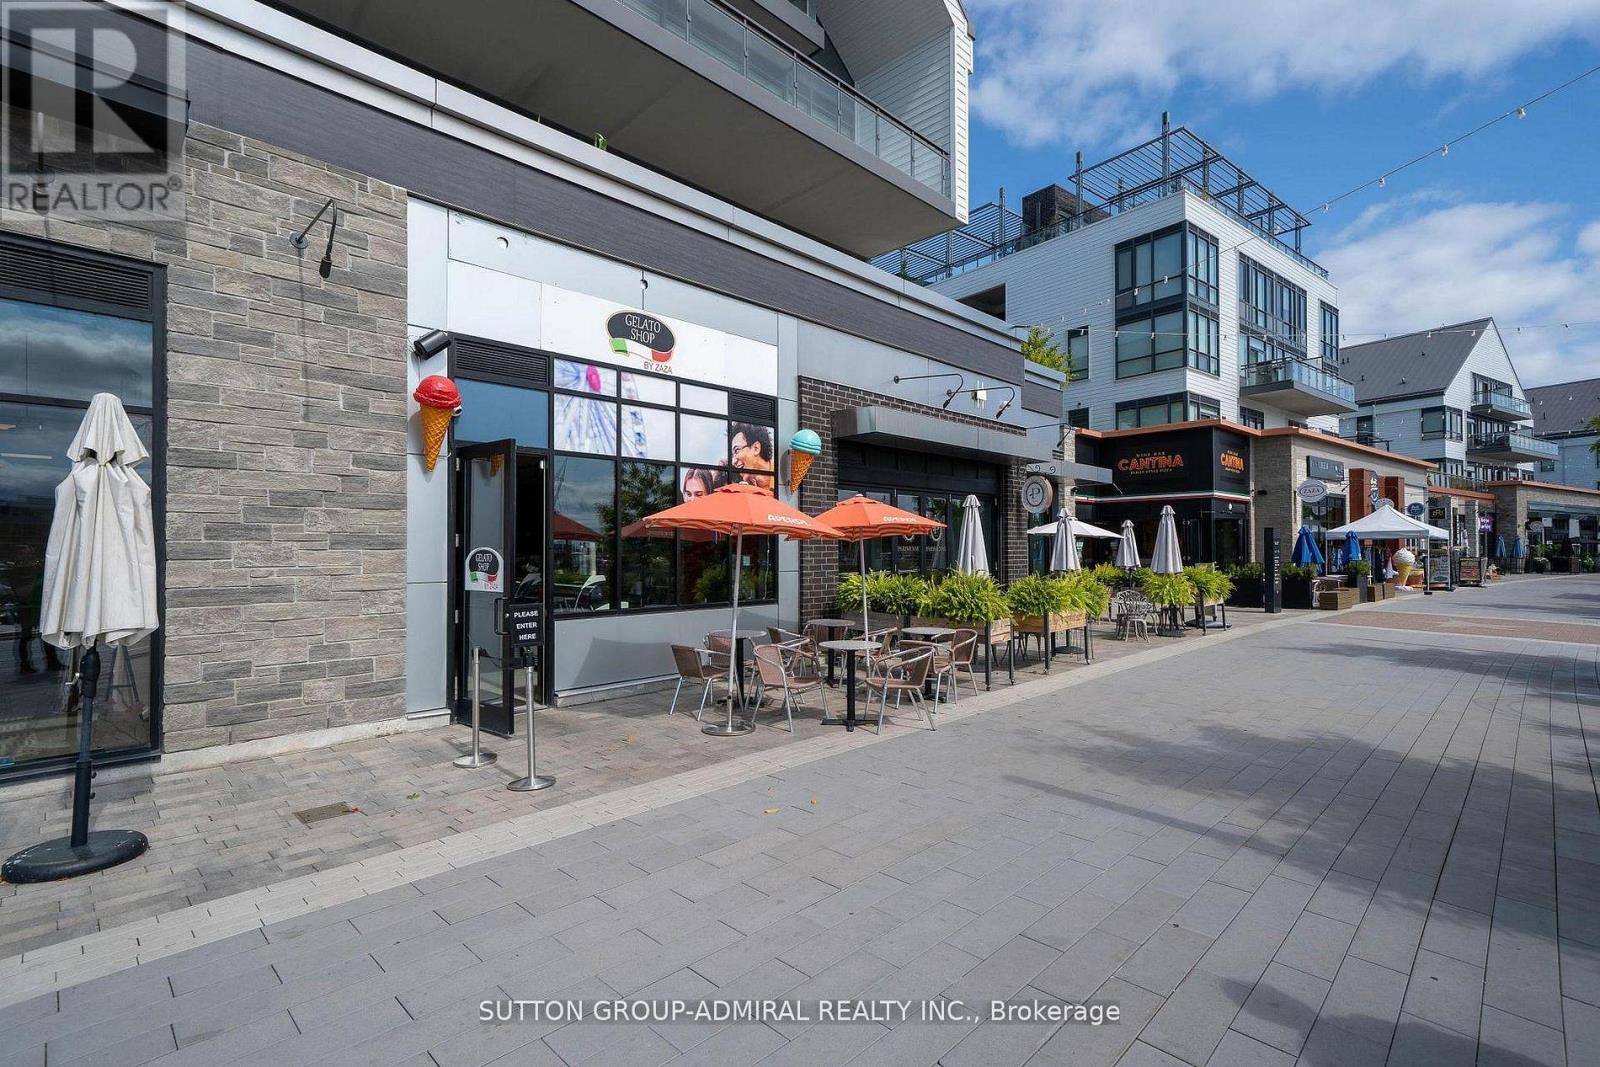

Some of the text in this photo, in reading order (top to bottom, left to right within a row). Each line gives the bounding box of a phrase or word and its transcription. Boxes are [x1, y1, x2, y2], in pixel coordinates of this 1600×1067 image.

[625, 314, 661, 333] GELATO
[630, 328, 655, 344] SHOP
[643, 361, 673, 374] BY ZAZA
[1117, 454, 1184, 471] CANTINA
[1220, 453, 1244, 471] CANTINA
[516, 622, 538, 630] ENTER
[518, 633, 537, 641] HERE
